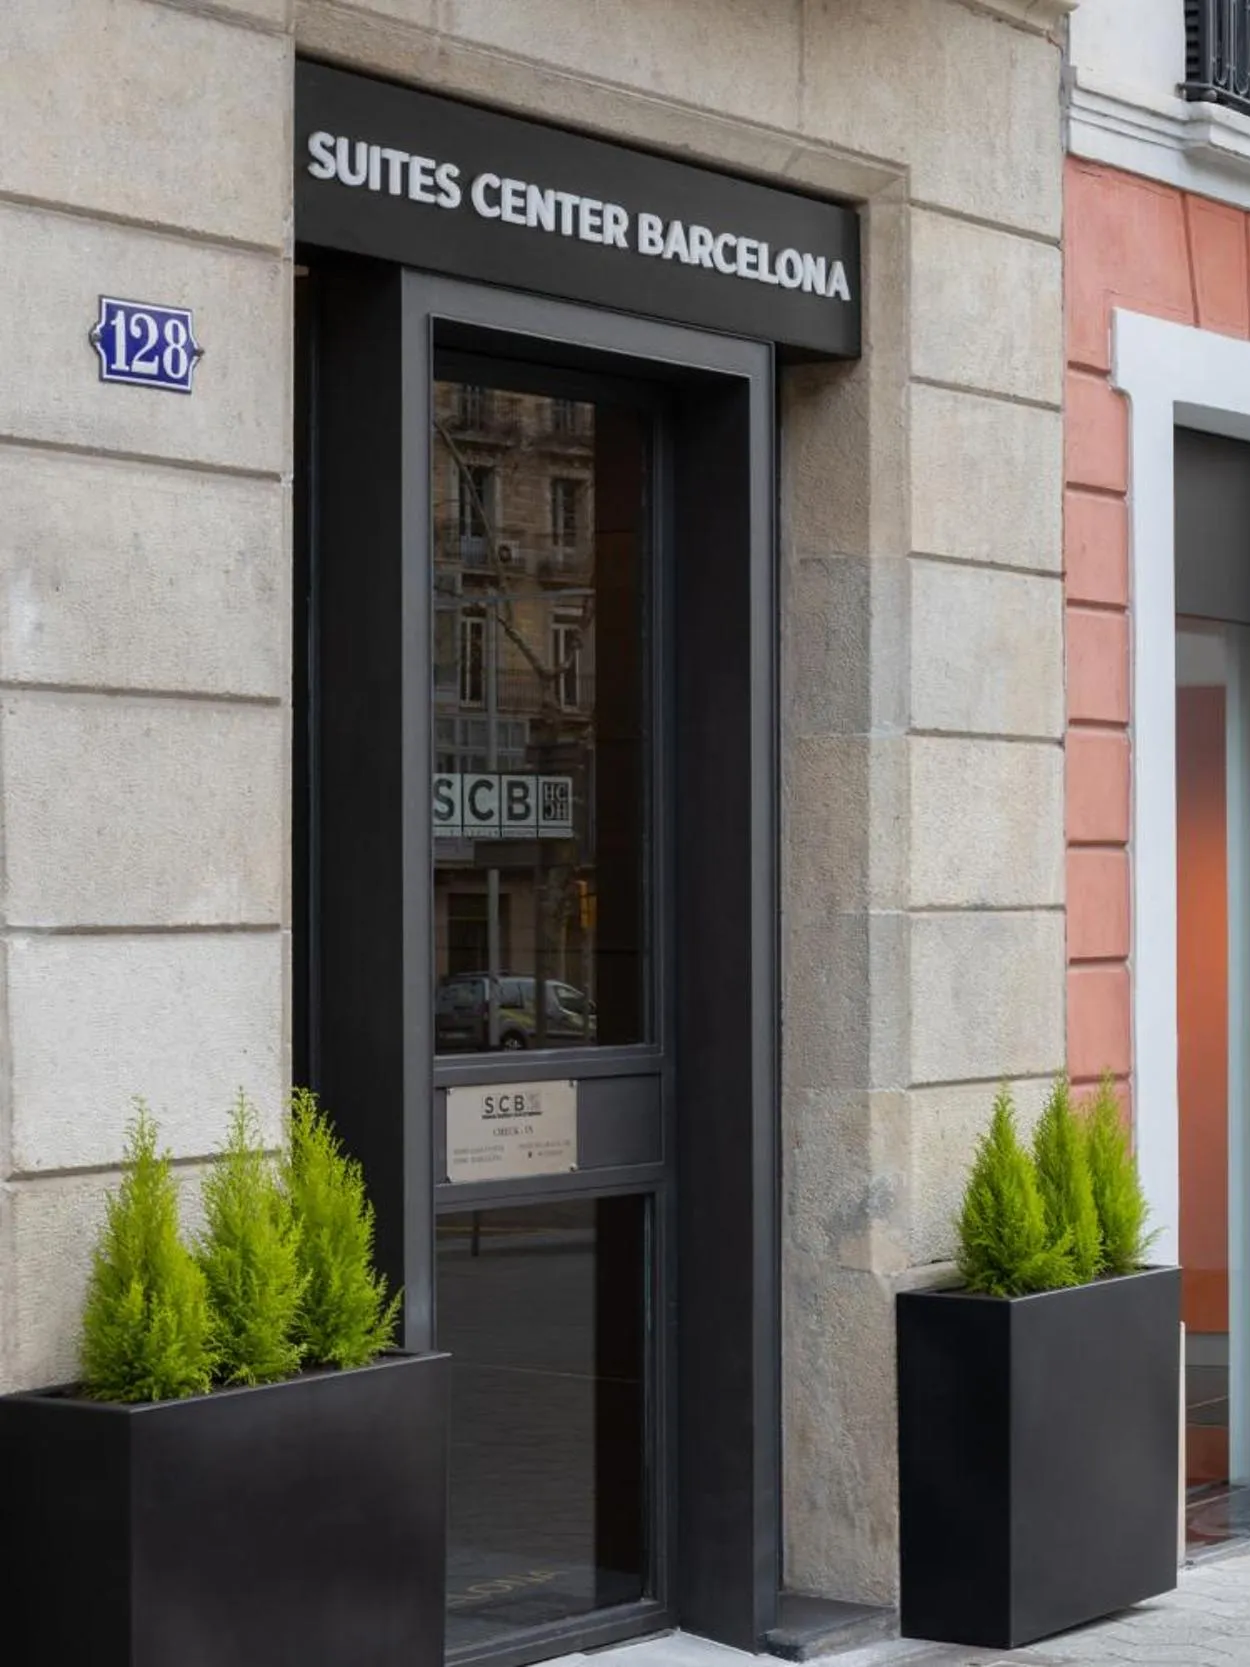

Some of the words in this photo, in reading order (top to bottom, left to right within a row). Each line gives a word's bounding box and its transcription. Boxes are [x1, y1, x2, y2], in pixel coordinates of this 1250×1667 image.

[307, 131, 461, 208] SUITES
[471, 172, 629, 248] CENTER
[637, 212, 851, 301] BARCELONA
[110, 309, 188, 379] 128
[484, 1095, 525, 1114] SCB
